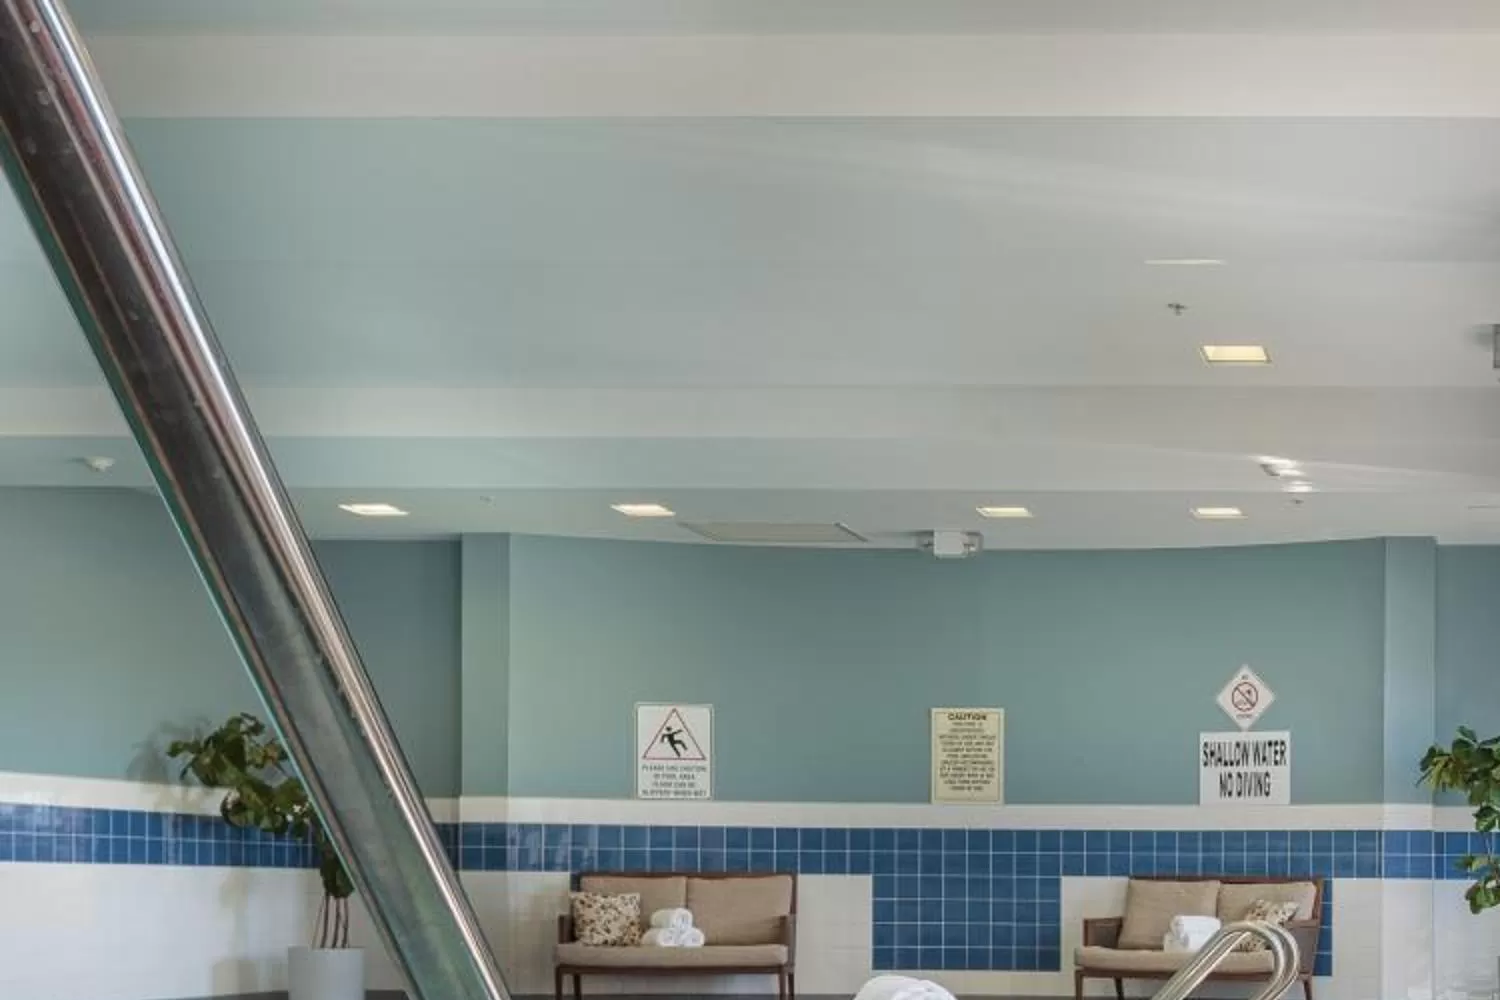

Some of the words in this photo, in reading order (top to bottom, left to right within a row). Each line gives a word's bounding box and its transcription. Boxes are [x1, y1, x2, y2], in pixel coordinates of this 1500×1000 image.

[947, 712, 987, 721] CAUTION
[1203, 741, 1249, 767] SHALLOW
[1253, 741, 1287, 767] WATER
[1220, 771, 1233, 798] NO
[1236, 771, 1271, 797] DIVING
